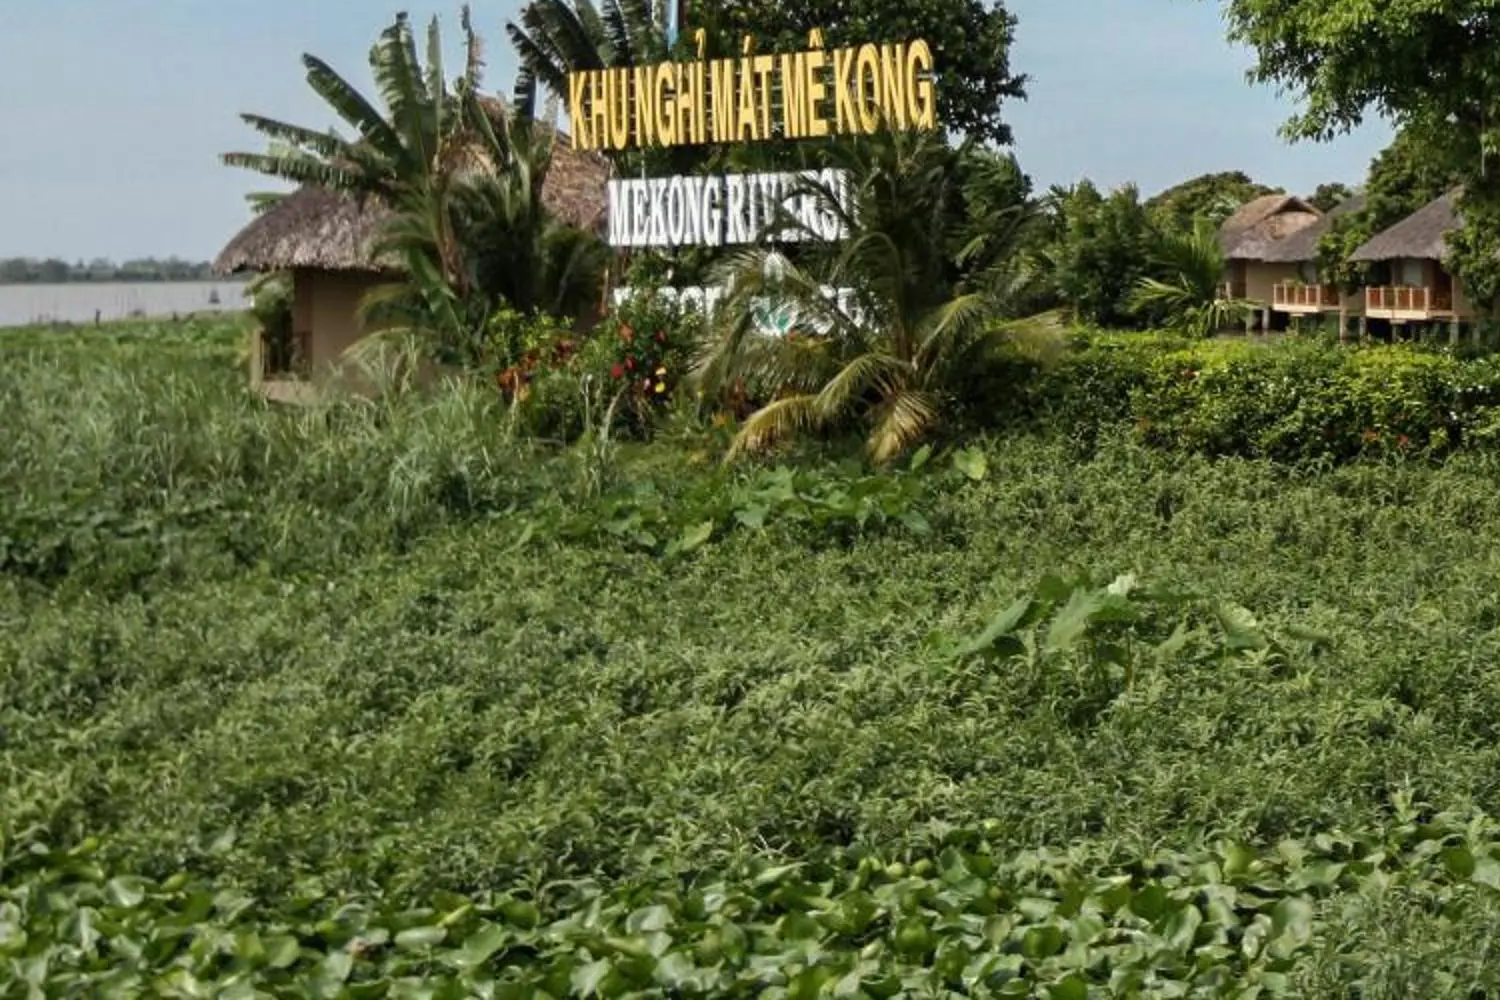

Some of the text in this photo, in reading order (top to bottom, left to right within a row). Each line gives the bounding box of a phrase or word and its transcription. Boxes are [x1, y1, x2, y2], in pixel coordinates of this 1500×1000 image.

[569, 26, 937, 151] KHU NGHỈ MÁT MÊ KONG
[607, 173, 722, 247] MEKONG
